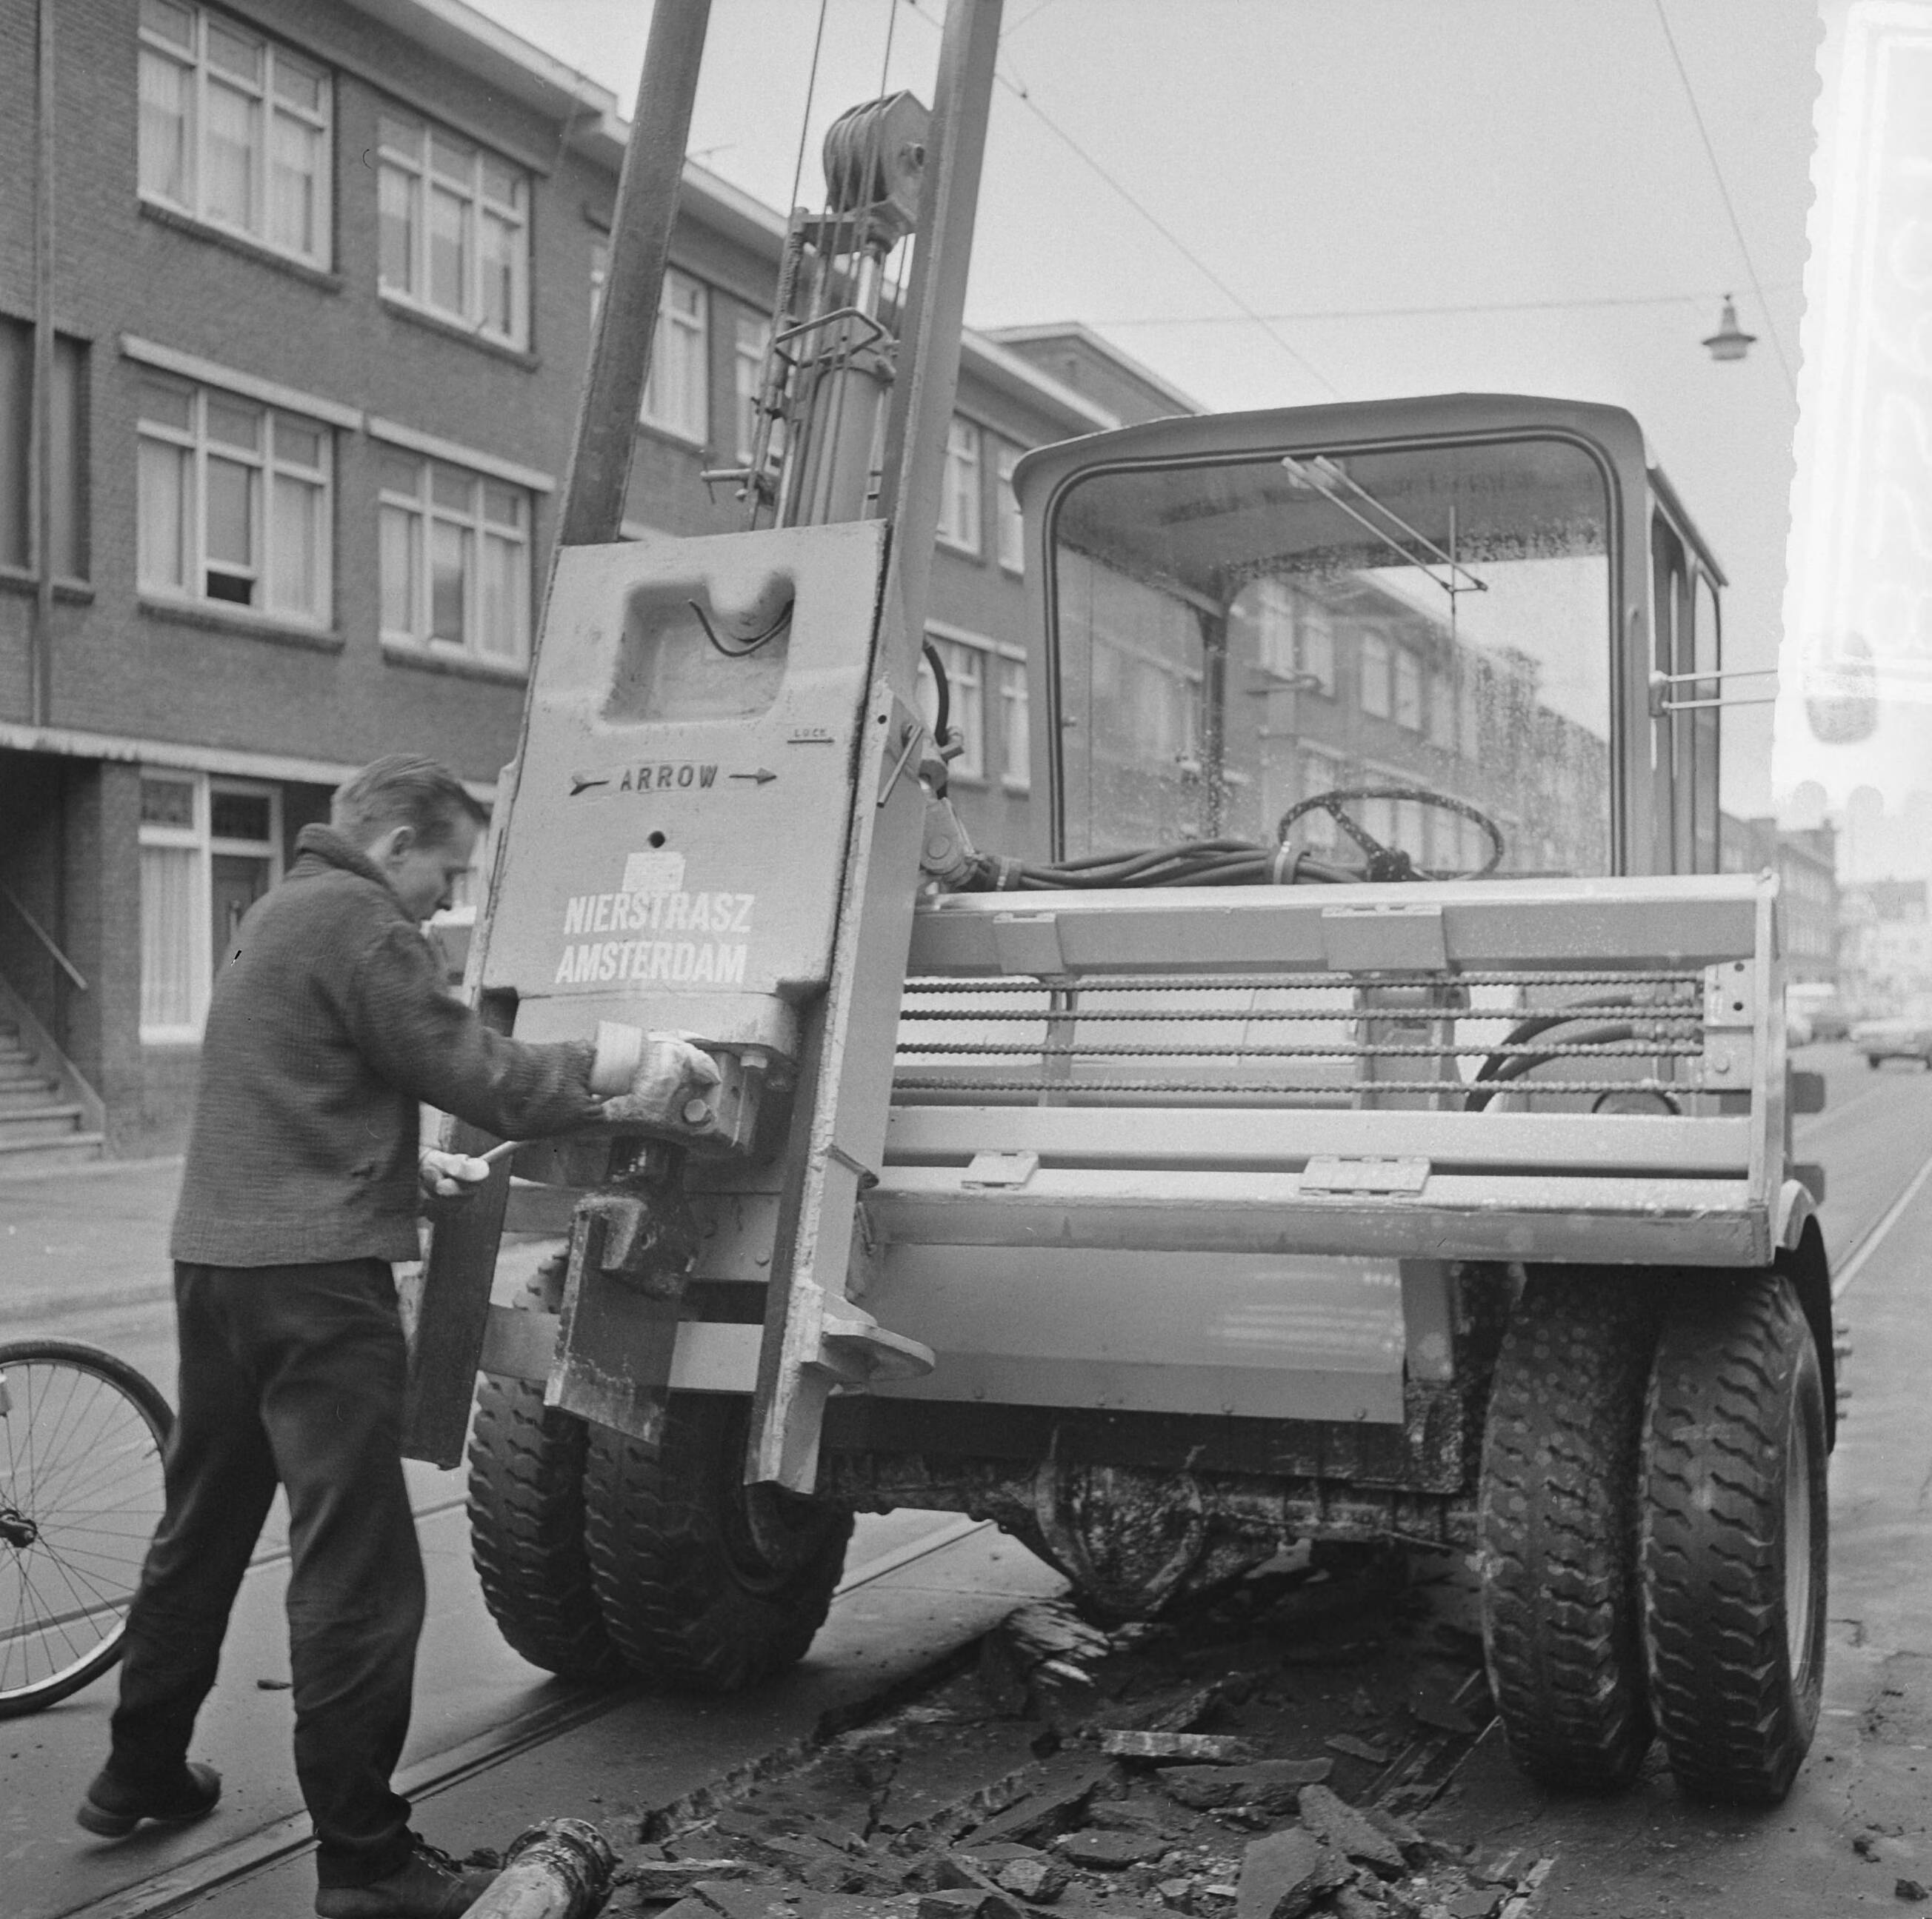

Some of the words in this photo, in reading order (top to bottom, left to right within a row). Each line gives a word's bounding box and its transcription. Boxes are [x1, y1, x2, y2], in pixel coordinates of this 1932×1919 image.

[620, 764, 718, 791] ARROW
[564, 891, 755, 935] NIERSTRASZ
[556, 941, 747, 984] AMSTERDAM
